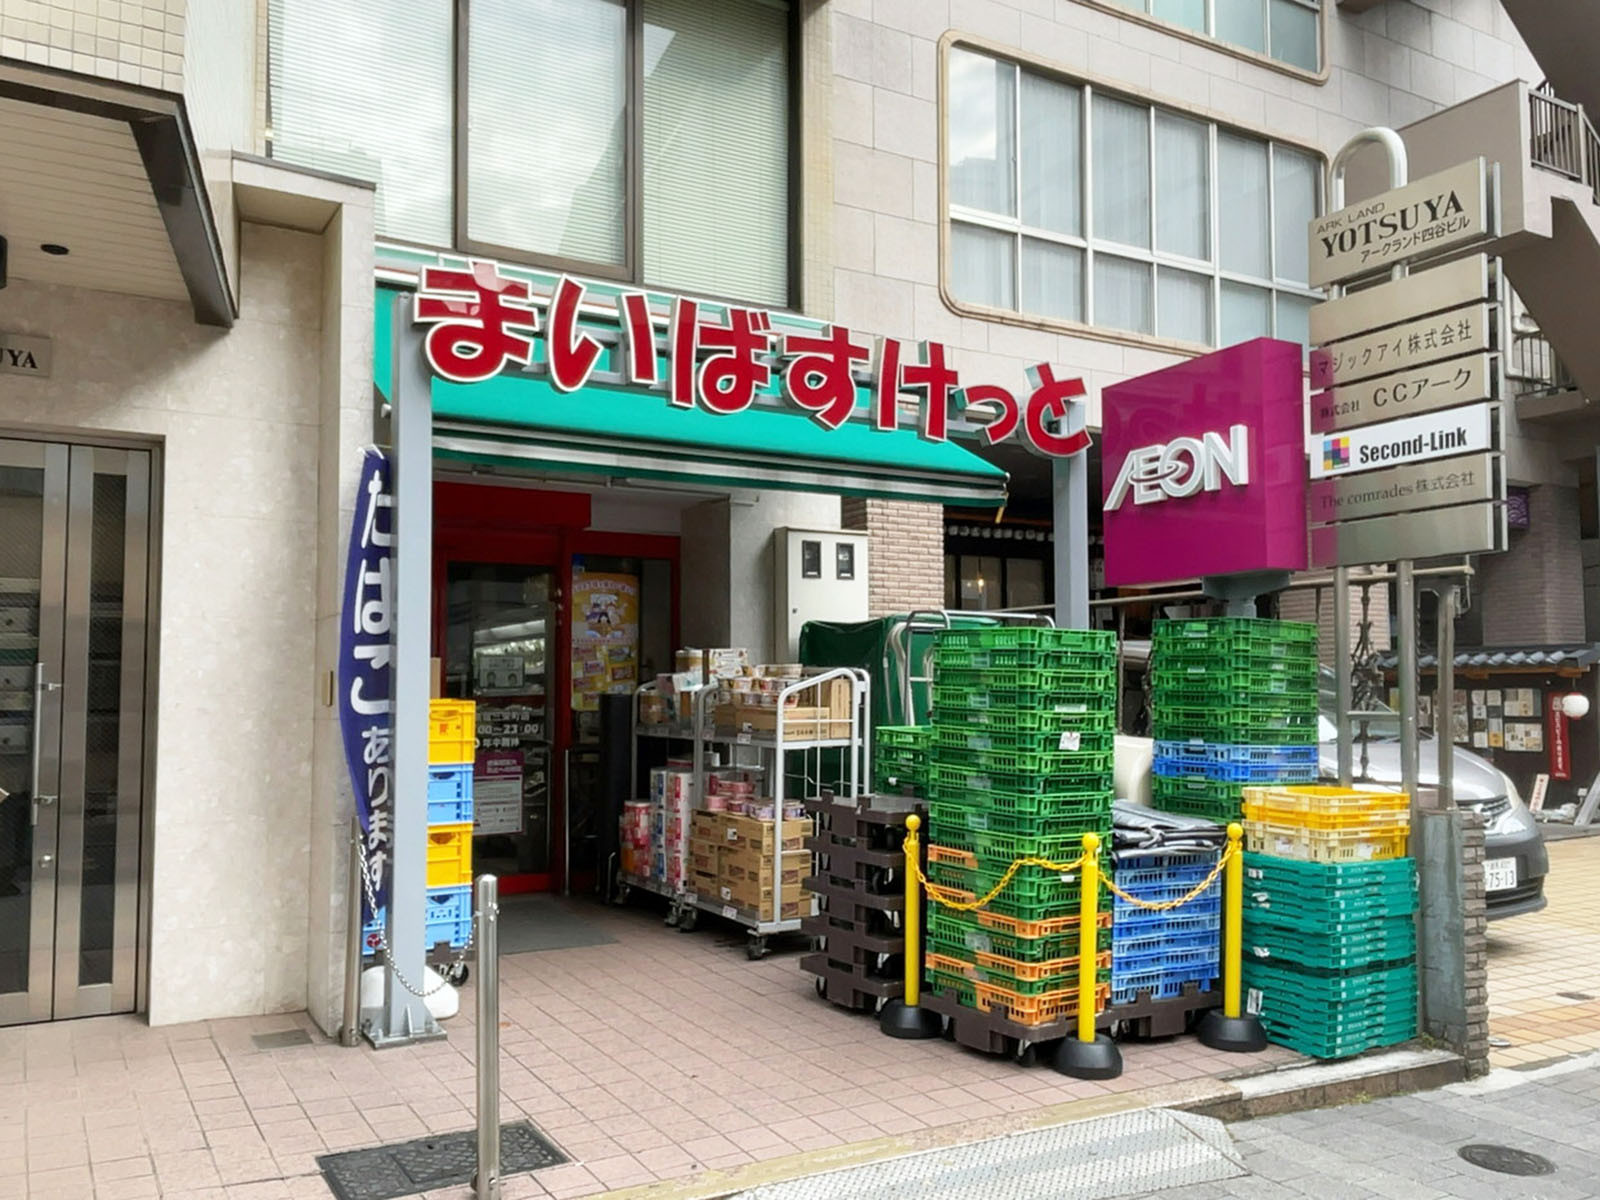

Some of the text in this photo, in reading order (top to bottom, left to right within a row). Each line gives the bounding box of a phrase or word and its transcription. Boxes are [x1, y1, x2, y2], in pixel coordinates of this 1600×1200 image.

[1316, 202, 1385, 235] ARK LAND
[1321, 189, 1465, 259] YOTSUYA
[1360, 215, 1471, 264] アークランド四谷ビル
[0, 347, 38, 369] YA
[413, 257, 1093, 458] まいばすけっと
[1318, 318, 1473, 376] マジックアイ株式会社
[1373, 367, 1472, 408] CCアーク
[1104, 424, 1248, 511] AEON
[1359, 427, 1468, 464] Second-Link
[1321, 470, 1476, 510] The comrades 株式会社
